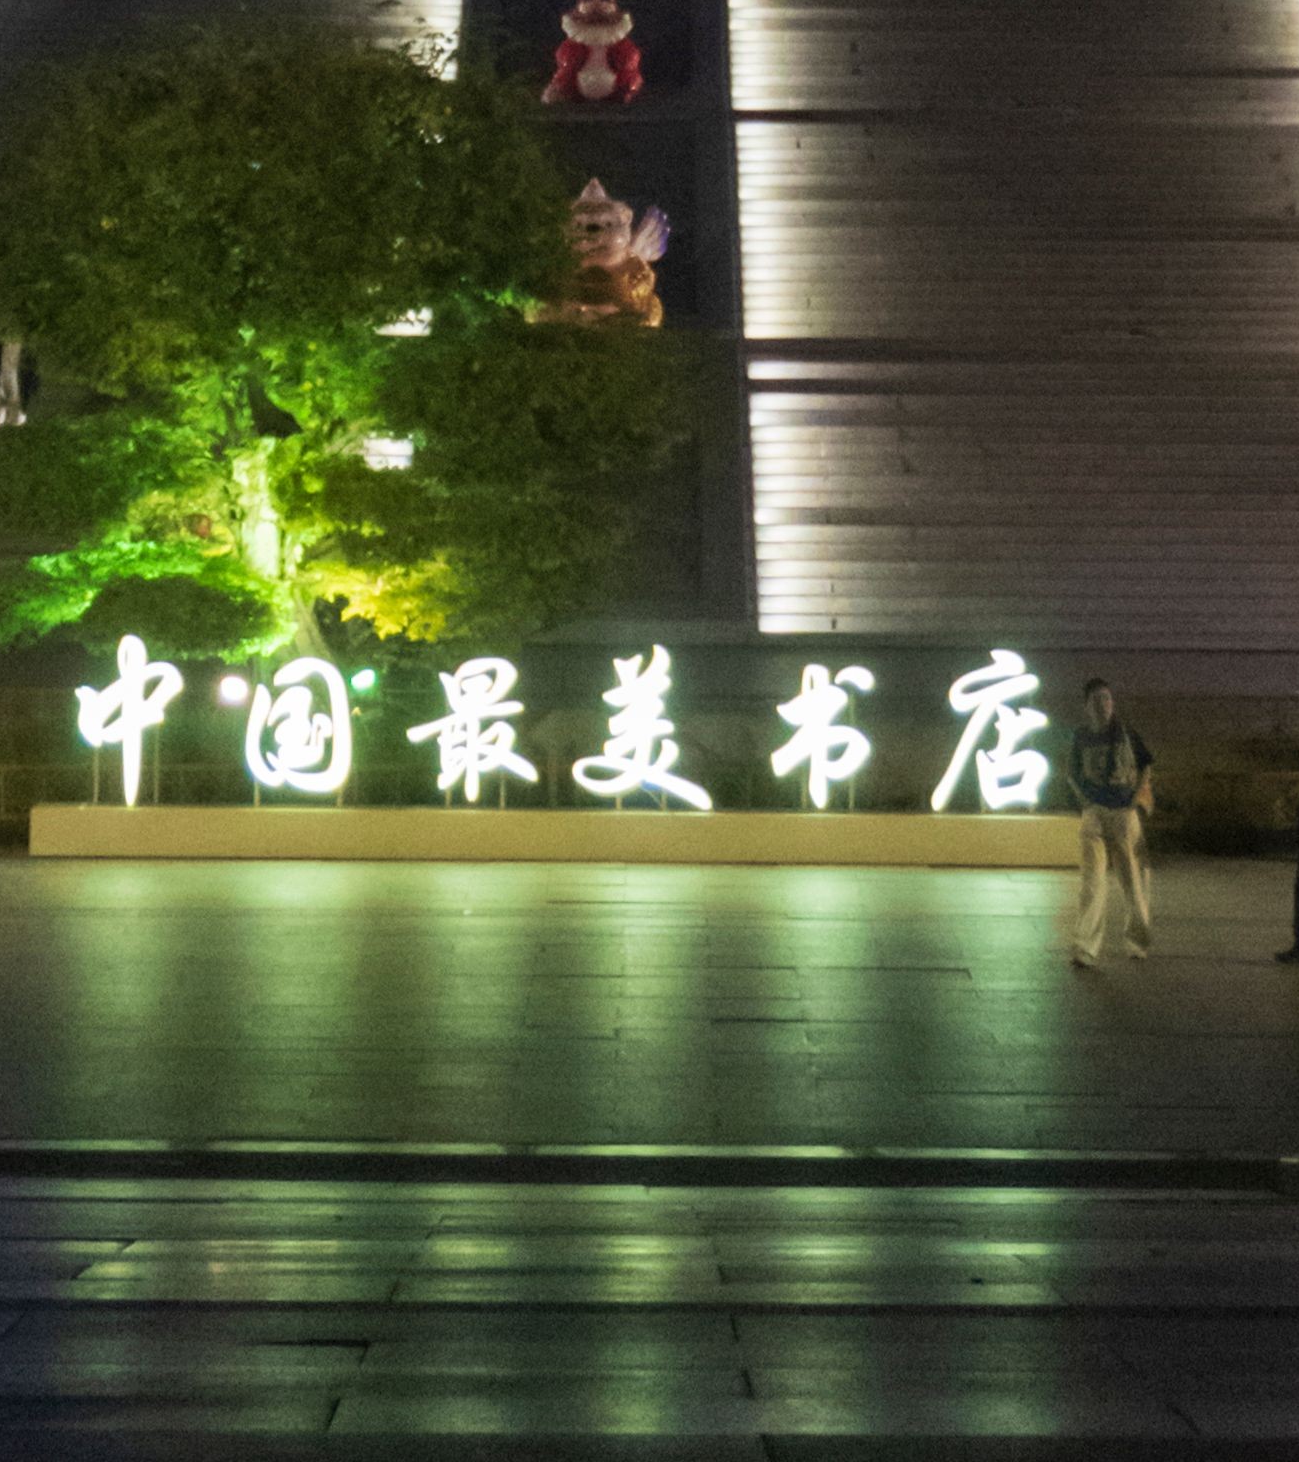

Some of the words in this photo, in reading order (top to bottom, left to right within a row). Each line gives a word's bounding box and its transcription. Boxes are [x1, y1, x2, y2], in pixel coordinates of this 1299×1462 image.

[75, 634, 1049, 811] 中国最美书店
